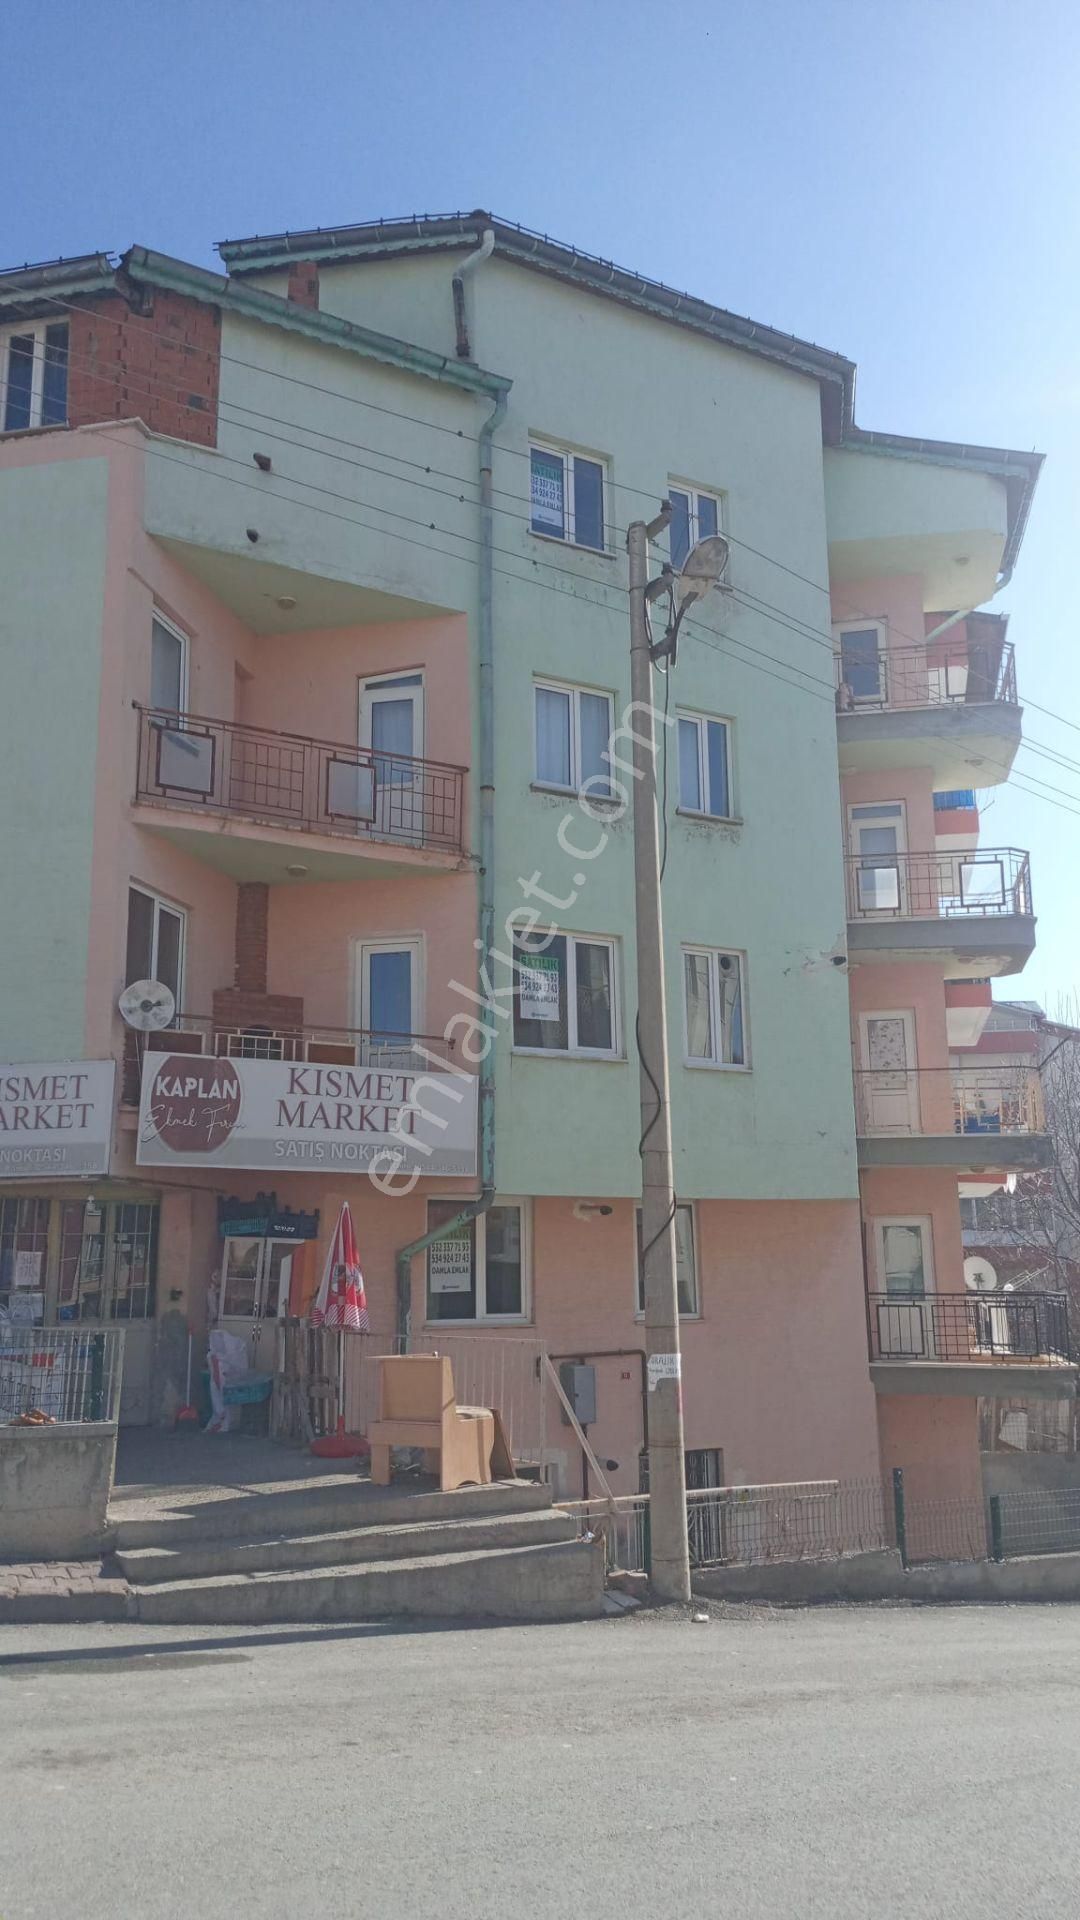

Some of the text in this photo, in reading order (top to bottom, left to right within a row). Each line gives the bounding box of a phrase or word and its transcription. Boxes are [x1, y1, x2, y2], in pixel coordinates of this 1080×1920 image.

[156, 1076, 238, 1099] KAPLAN
[287, 1067, 415, 1103] KISMET
[0, 1103, 94, 1131] ARKET
[275, 1099, 421, 1135] MARKET
[275, 1140, 407, 1163] SATIŞ NOKTASI
